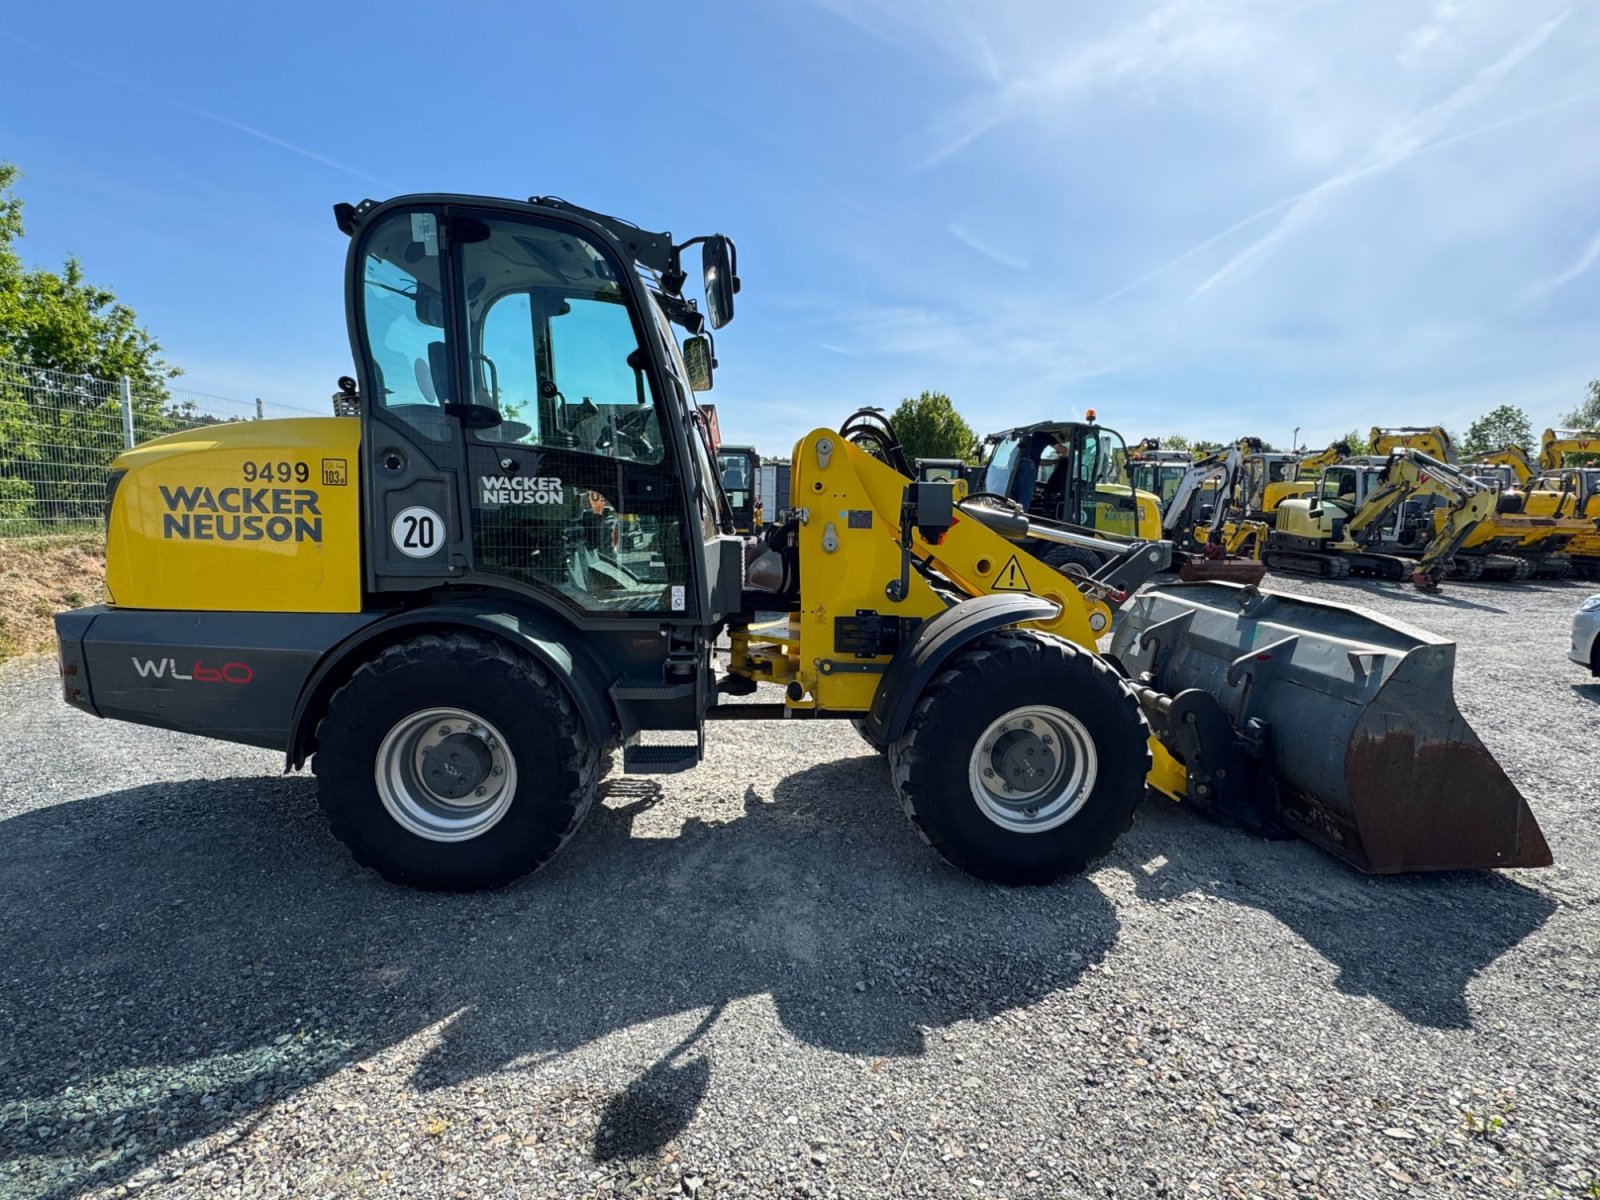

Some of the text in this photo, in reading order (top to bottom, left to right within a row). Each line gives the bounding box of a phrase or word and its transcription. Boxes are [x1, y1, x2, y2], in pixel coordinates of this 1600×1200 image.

[243, 461, 310, 483] 9499
[325, 470, 339, 483] 103
[481, 476, 563, 491] WACKER
[159, 485, 322, 516] WACKER
[483, 490, 563, 504] NEUSON
[164, 513, 322, 543] NEUSON
[403, 515, 434, 549] 20
[131, 656, 254, 684] WL60
